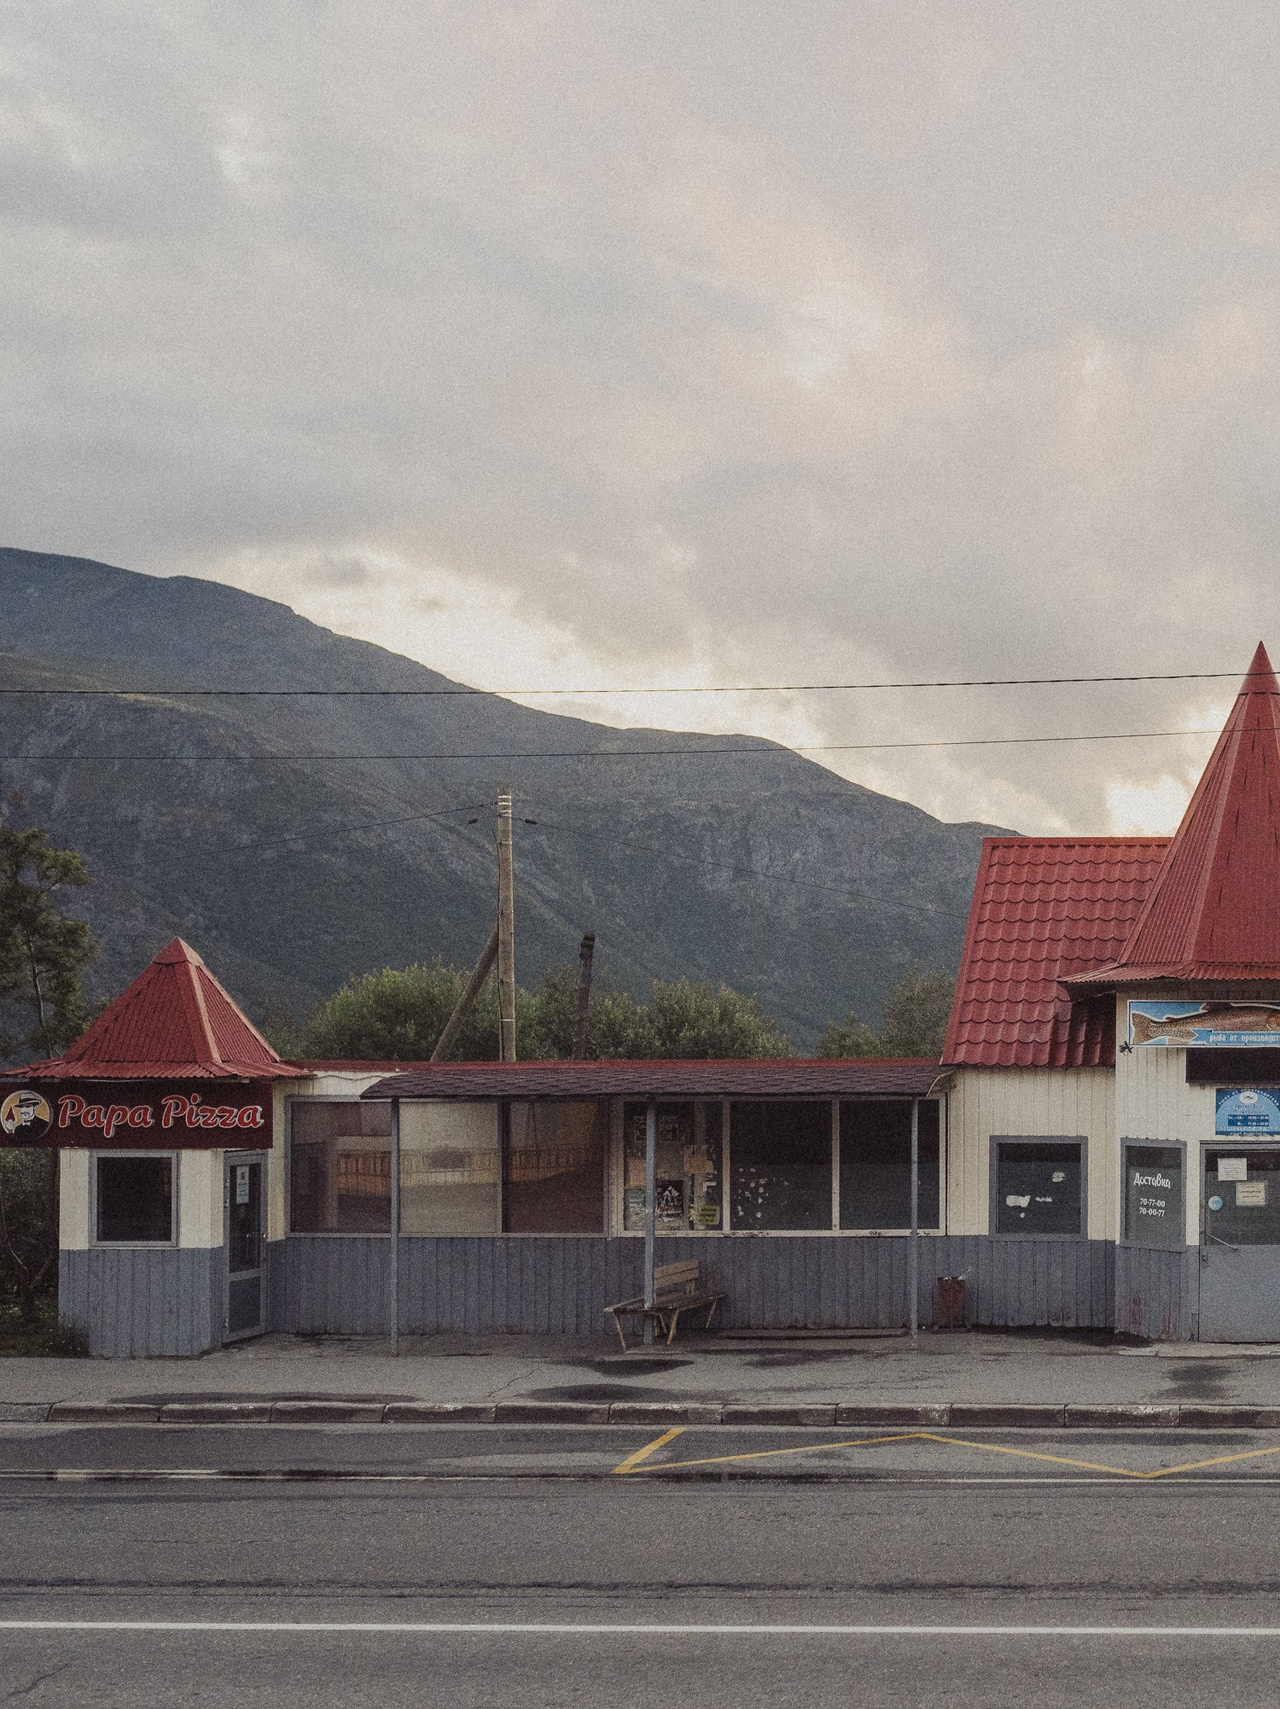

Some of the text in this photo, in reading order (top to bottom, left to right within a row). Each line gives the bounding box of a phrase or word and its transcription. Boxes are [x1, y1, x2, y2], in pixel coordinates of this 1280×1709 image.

[58, 1093, 265, 1138] Papa Pizza
[1133, 1172, 1171, 1189] Доставка
[1140, 1197, 1166, 1207] 70-77-00
[1139, 1207, 1165, 1217] 70-00-77
